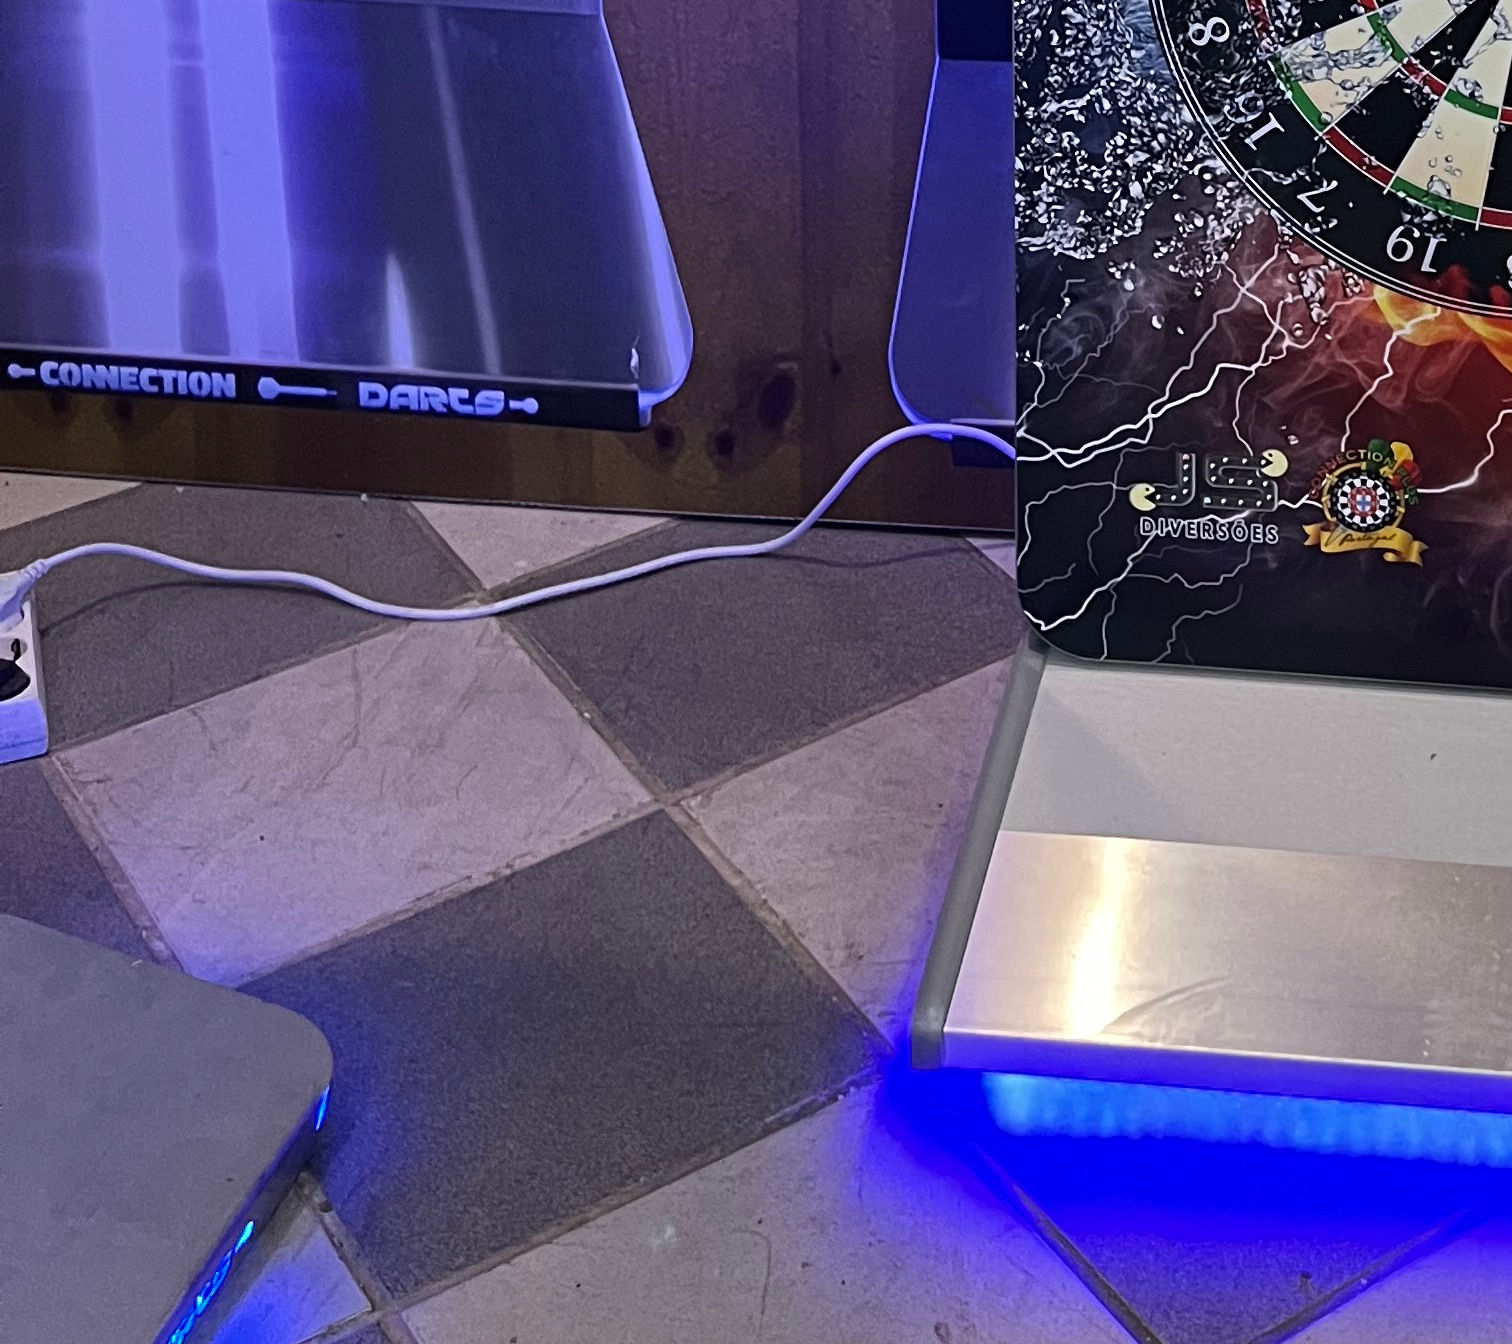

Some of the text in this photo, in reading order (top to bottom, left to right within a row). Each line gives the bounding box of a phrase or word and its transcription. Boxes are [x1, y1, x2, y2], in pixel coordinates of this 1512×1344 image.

[1188, 16, 1230, 47] 8
[1223, 91, 1285, 151] 16
[1297, 179, 1338, 213] 7
[1385, 224, 1447, 273] 19
[40, 361, 504, 417] CONNECTION DARTS
[1140, 517, 1279, 544] DIVERSÕES
